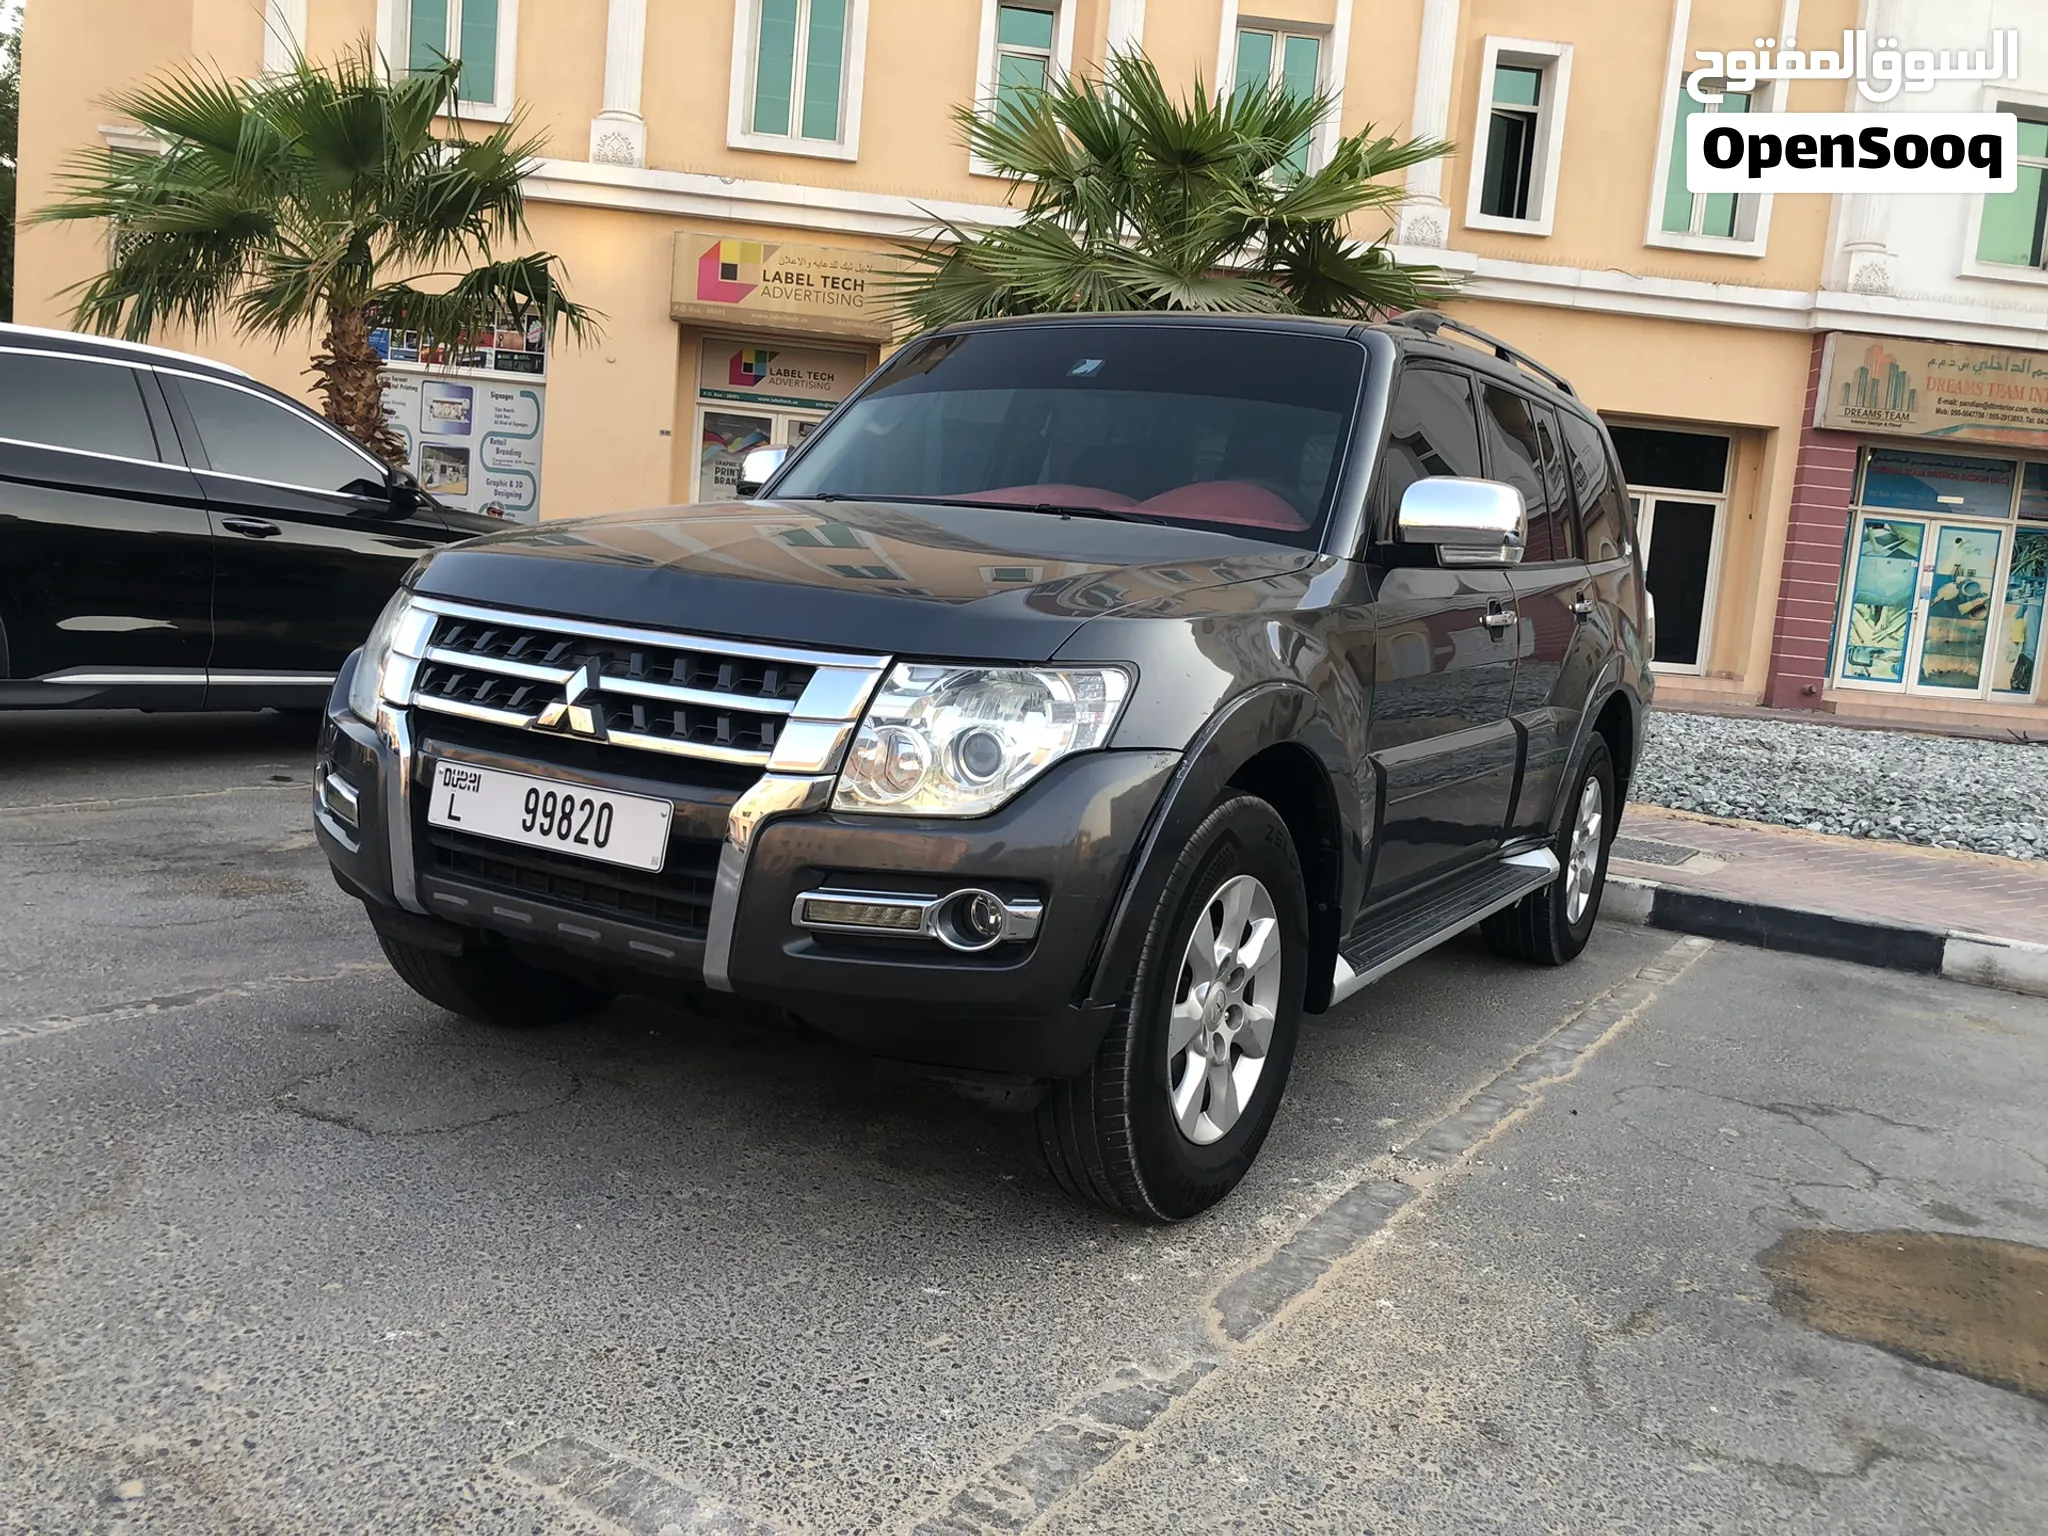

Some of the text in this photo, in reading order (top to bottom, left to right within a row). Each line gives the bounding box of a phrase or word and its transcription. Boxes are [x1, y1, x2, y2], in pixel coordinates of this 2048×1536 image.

[762, 269, 865, 292] LABEL TECH
[760, 285, 864, 308] ADVERTISING
[769, 367, 835, 382] LABEL TECH
[400, 384, 418, 392] Printing
[768, 377, 831, 391] ADVERTISING
[1926, 376, 1983, 397] DREAMS
[1988, 382, 2025, 401] TEAM
[490, 391, 514, 401] Signages
[1844, 407, 1910, 421] DREAMS TEAM
[490, 437, 507, 446] Retail
[496, 446, 522, 458] Branding
[486, 478, 524, 488] Graphic & 3D
[494, 488, 522, 500] Designing
[447, 788, 614, 848] L 99820
